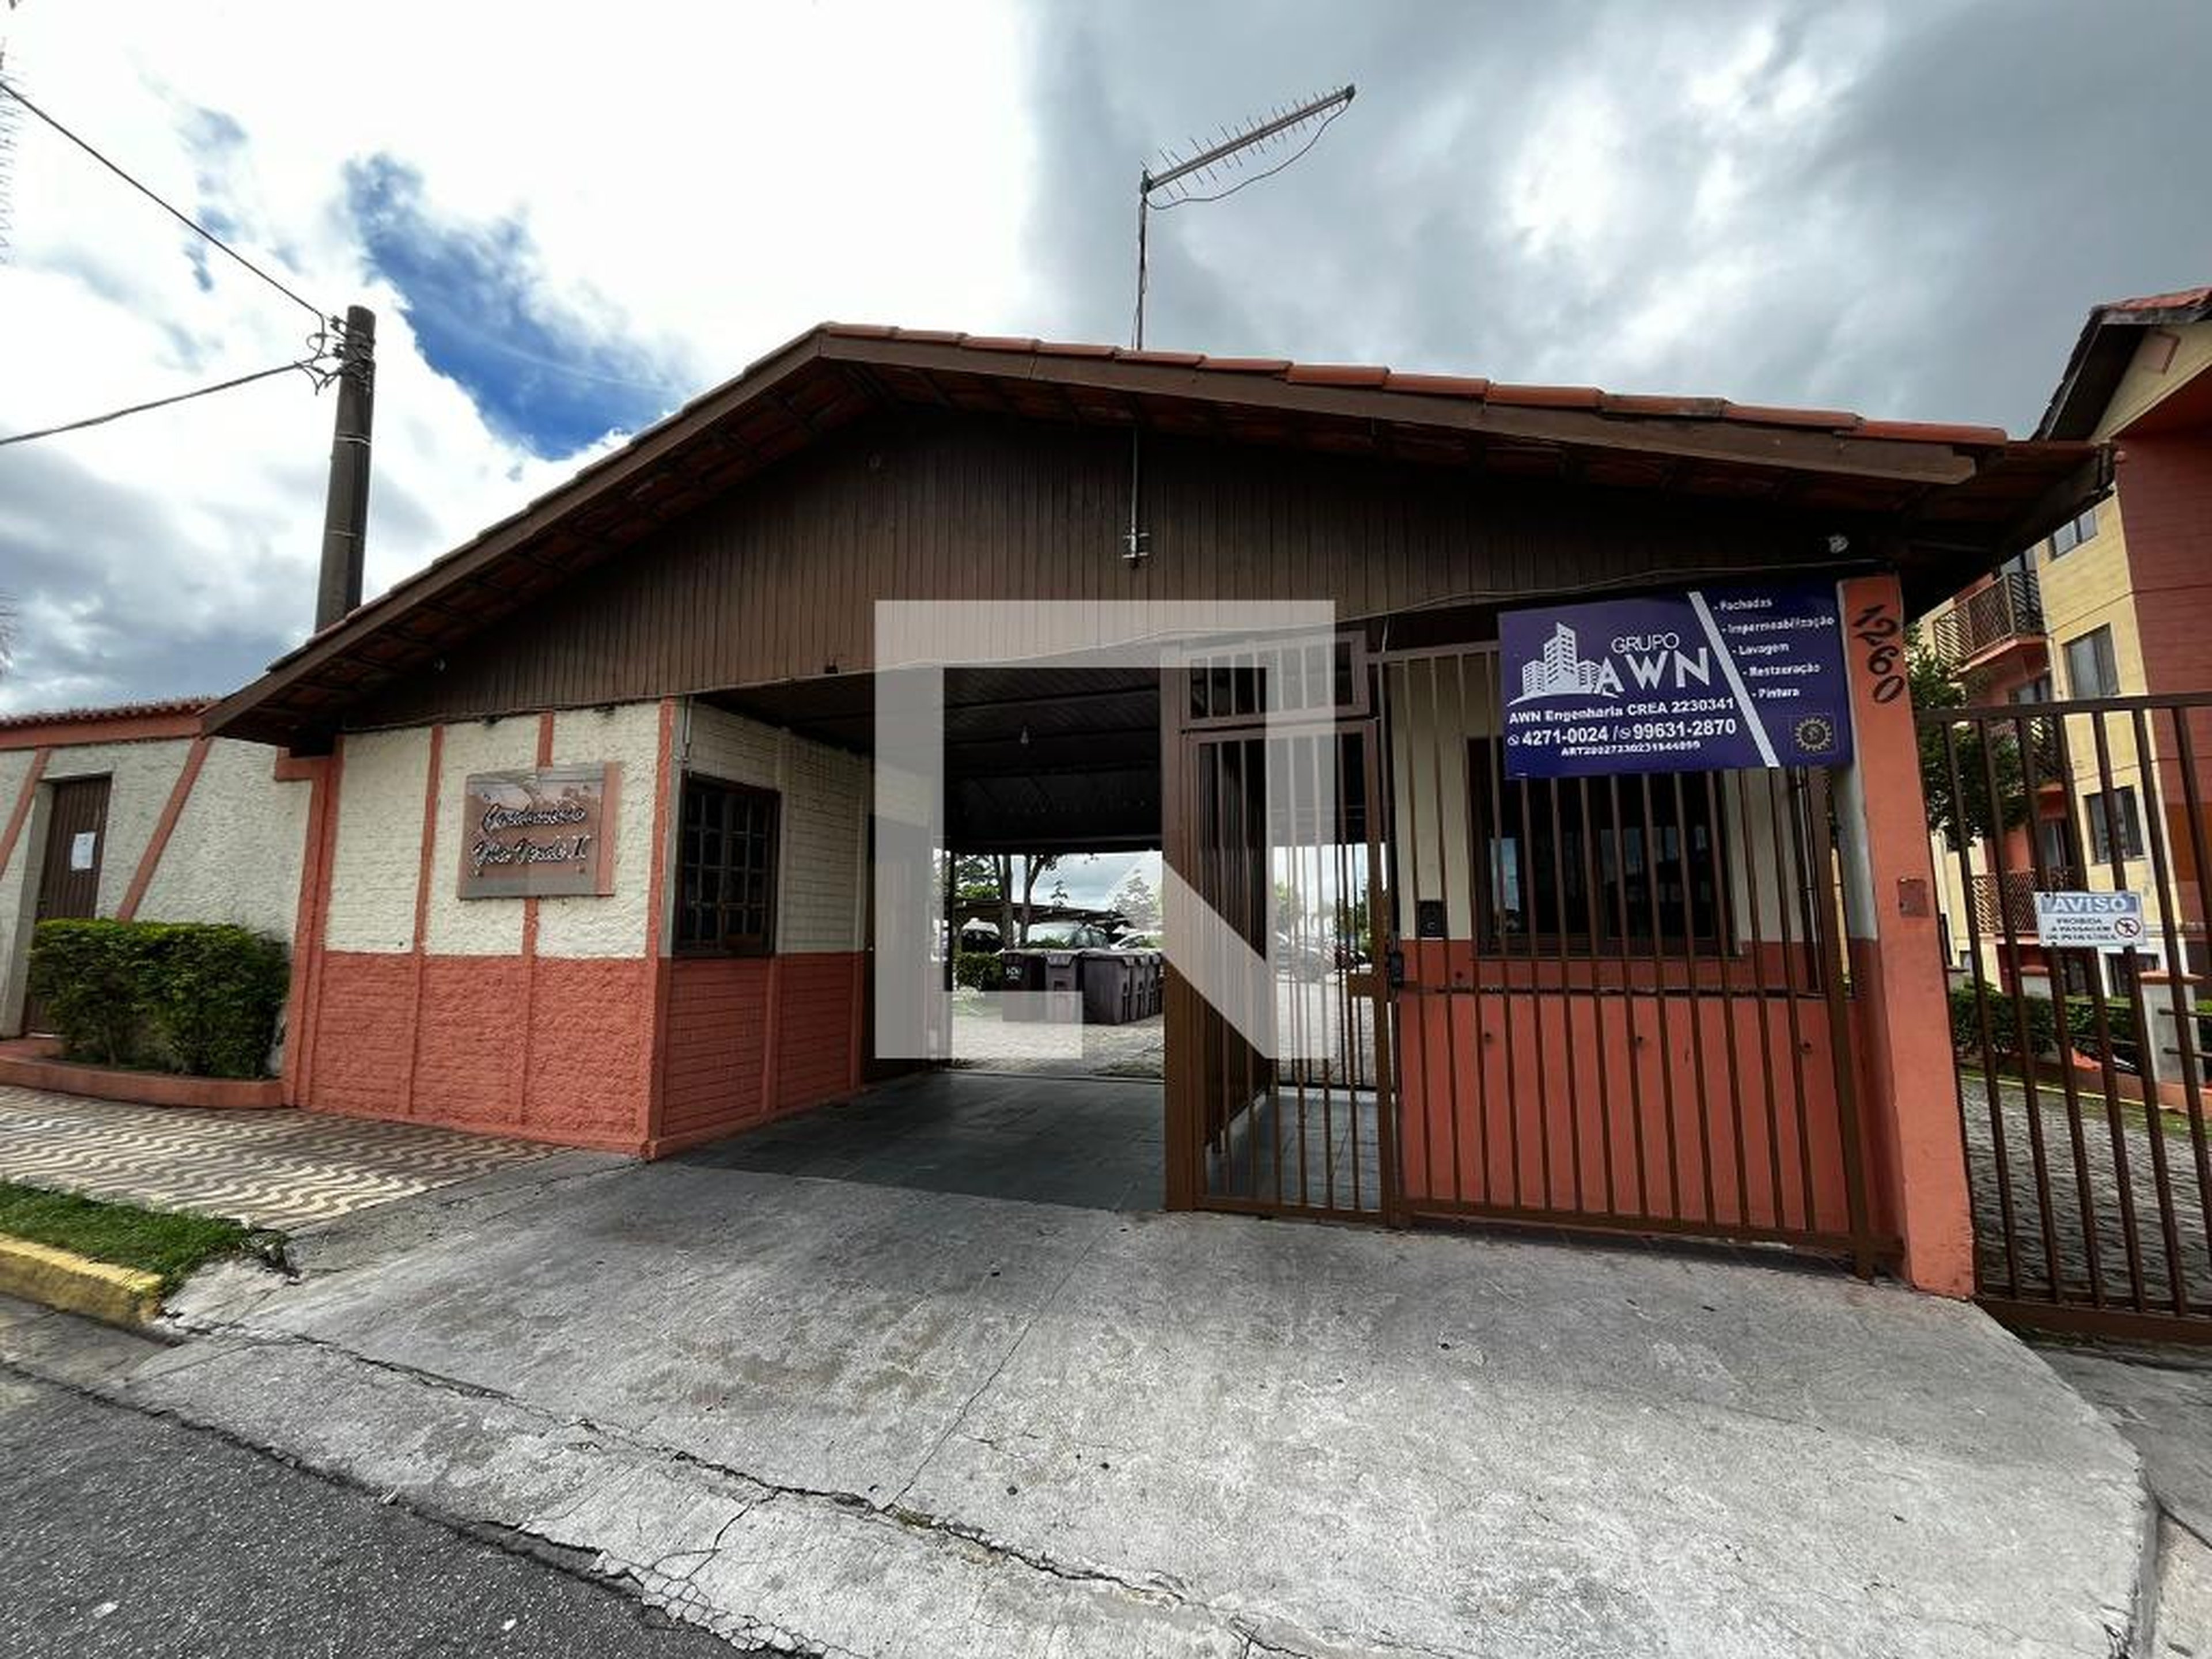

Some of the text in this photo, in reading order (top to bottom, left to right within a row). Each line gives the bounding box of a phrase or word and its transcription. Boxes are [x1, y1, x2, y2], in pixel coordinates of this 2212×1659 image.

[1719, 598, 1772, 611] Fachadas
[1611, 632, 1680, 654] GRUPO
[1738, 643, 1789, 656] Lavagem
[1852, 605, 1904, 704] 1260
[1594, 647, 1710, 694] AWN
[1758, 688, 1800, 699] Pintura
[1509, 697, 1734, 724] AWN Engenharia CREA 2230341
[1522, 725, 1608, 746] 4271-0024
[1633, 718, 1736, 740] 99631-2870
[2052, 896, 2127, 912] AVISO
